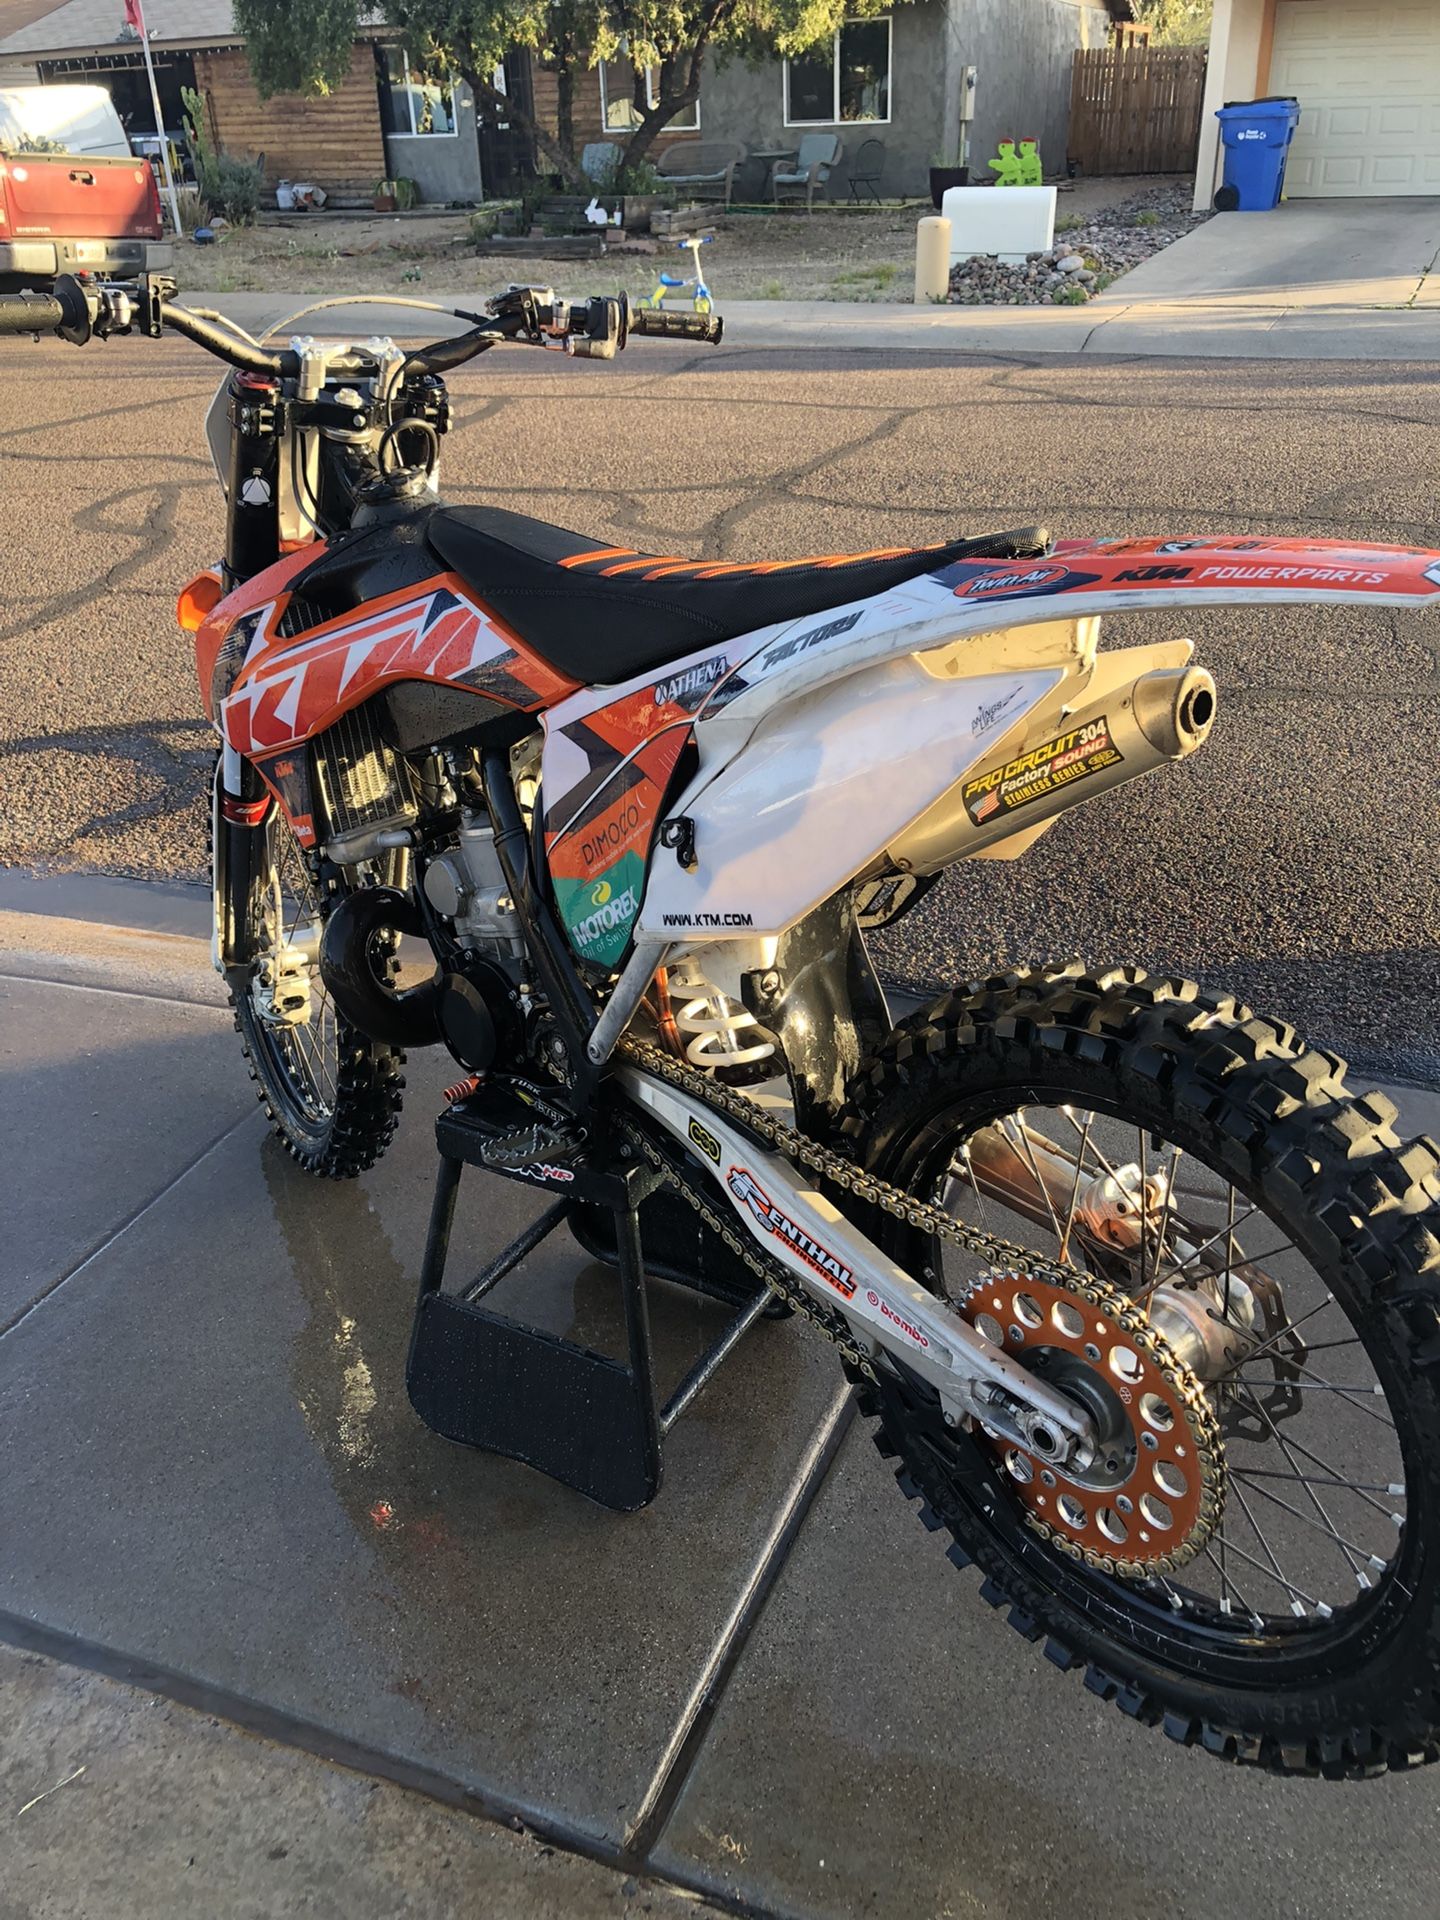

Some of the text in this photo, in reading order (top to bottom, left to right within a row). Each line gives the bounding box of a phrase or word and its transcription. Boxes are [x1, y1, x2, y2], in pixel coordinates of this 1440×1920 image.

[968, 566, 1054, 594] Twin Air
[1111, 564, 1390, 584] KTM POWERPARTS
[761, 610, 866, 672] FACTORY
[667, 656, 727, 698] ATHENA
[964, 768, 1003, 799] PRO
[1001, 730, 1080, 782] CIRCUIT
[1078, 718, 1107, 745] 304
[1000, 763, 1052, 795] Factory
[1053, 735, 1108, 771] SOUND
[1004, 778, 1052, 806] STAINLESS
[1053, 761, 1087, 782] SERIES
[581, 805, 639, 866] DIMOCO
[572, 886, 639, 948] MOTOREX
[662, 913, 753, 927] WWW.KTM.COM
[582, 945, 595, 958] Oil
[596, 939, 606, 953] of
[774, 1229, 851, 1298] CHAINWHEELS
[880, 1302, 929, 1348] brembo
